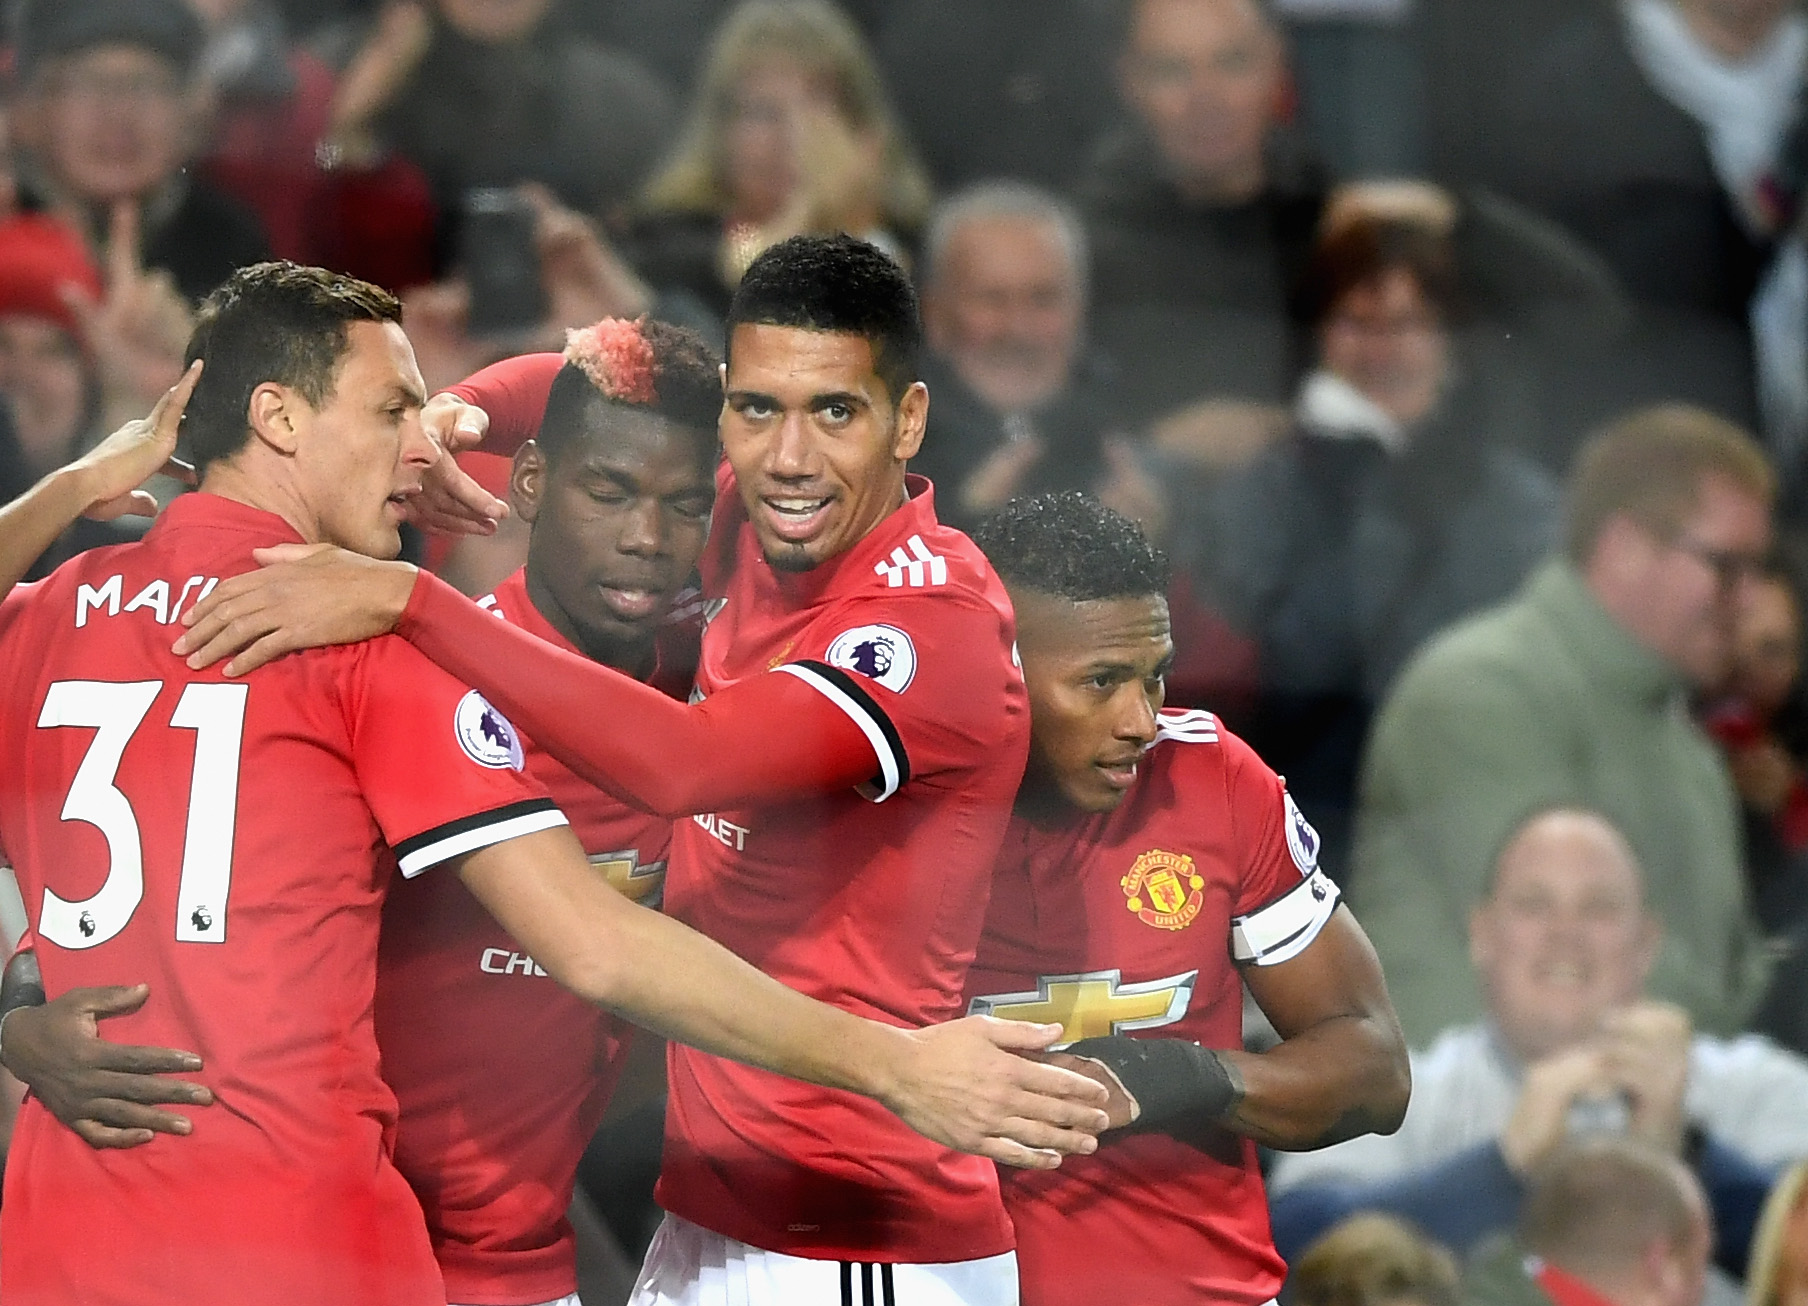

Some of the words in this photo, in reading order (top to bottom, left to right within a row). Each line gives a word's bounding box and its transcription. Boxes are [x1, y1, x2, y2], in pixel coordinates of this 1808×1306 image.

[36, 679, 250, 950] 31
[1127, 854, 1190, 891] MANCHESTER
[1154, 903, 1197, 925] UNITED
